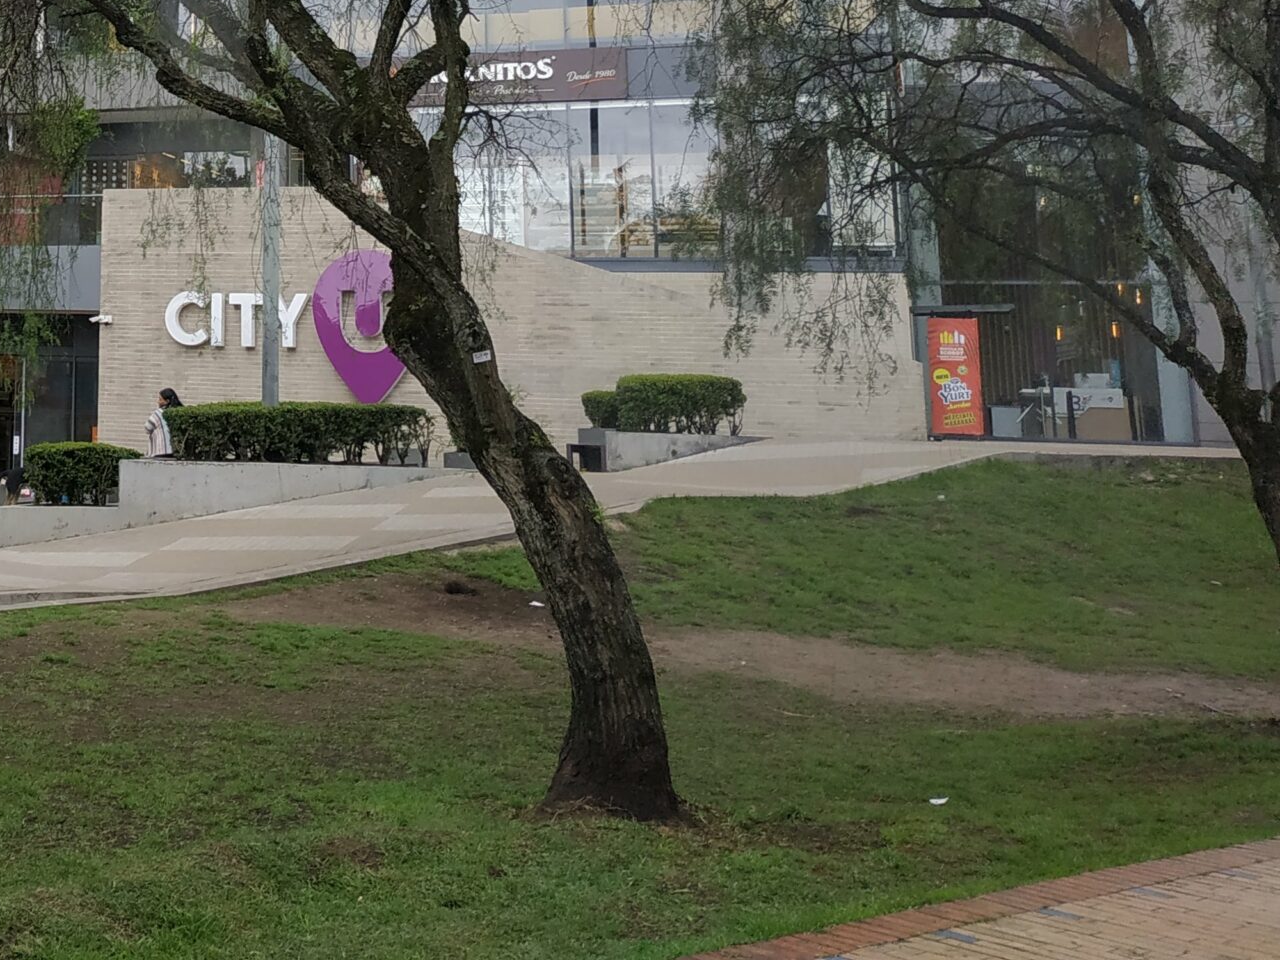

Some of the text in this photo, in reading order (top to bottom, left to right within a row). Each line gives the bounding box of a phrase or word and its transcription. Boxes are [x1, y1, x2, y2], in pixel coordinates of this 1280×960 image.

[595, 69, 617, 78] 1980
[165, 291, 309, 347] CITY
[943, 383, 966, 393] BON
[939, 391, 970, 404] YURT
